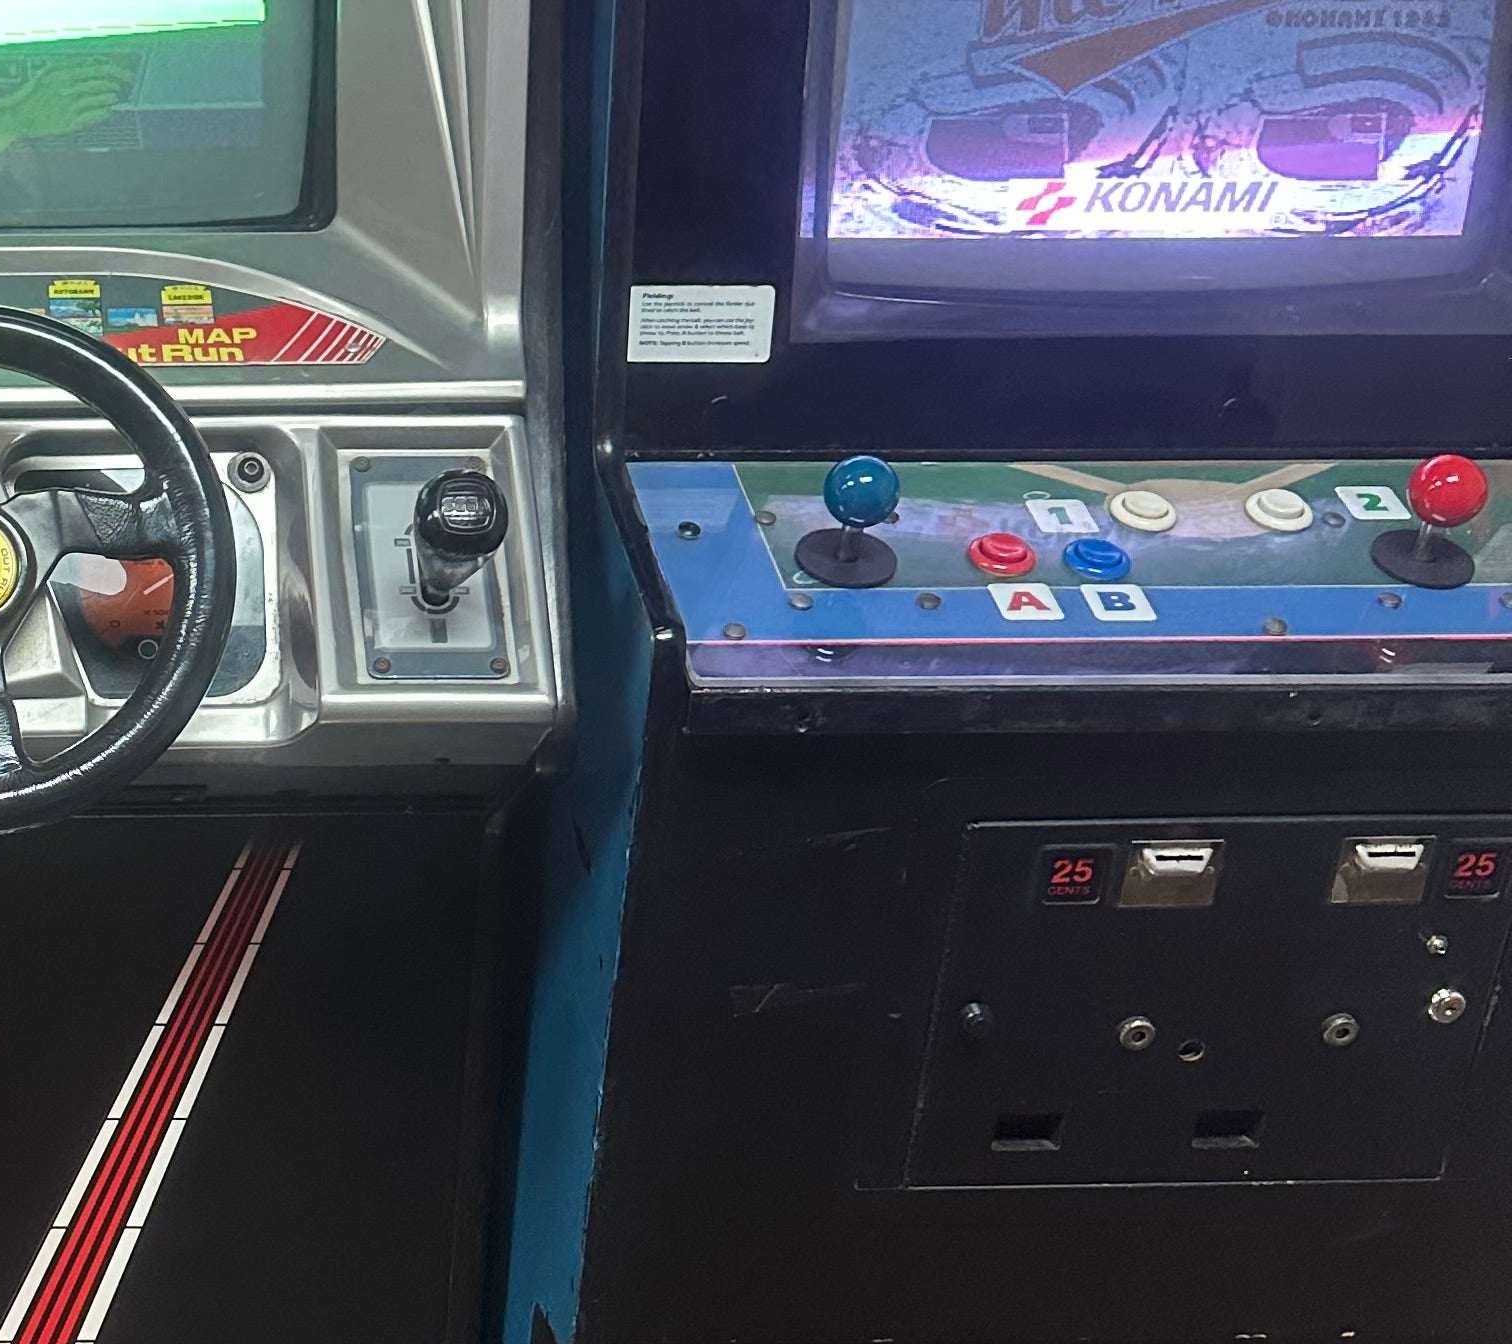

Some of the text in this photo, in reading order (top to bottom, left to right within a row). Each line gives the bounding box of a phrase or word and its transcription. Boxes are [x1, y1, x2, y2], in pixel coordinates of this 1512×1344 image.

[1084, 181, 1279, 213] KONAMI
[178, 328, 257, 345] MAP
[119, 342, 244, 363] ut Run
[1356, 493, 1395, 513] 2
[1047, 506, 1072, 525] 1
[0, 547, 11, 573] OUT
[1006, 592, 1137, 612] A B
[1051, 858, 1095, 884] 25
[1454, 852, 1497, 877] 25
[1048, 886, 1091, 895] CENTS
